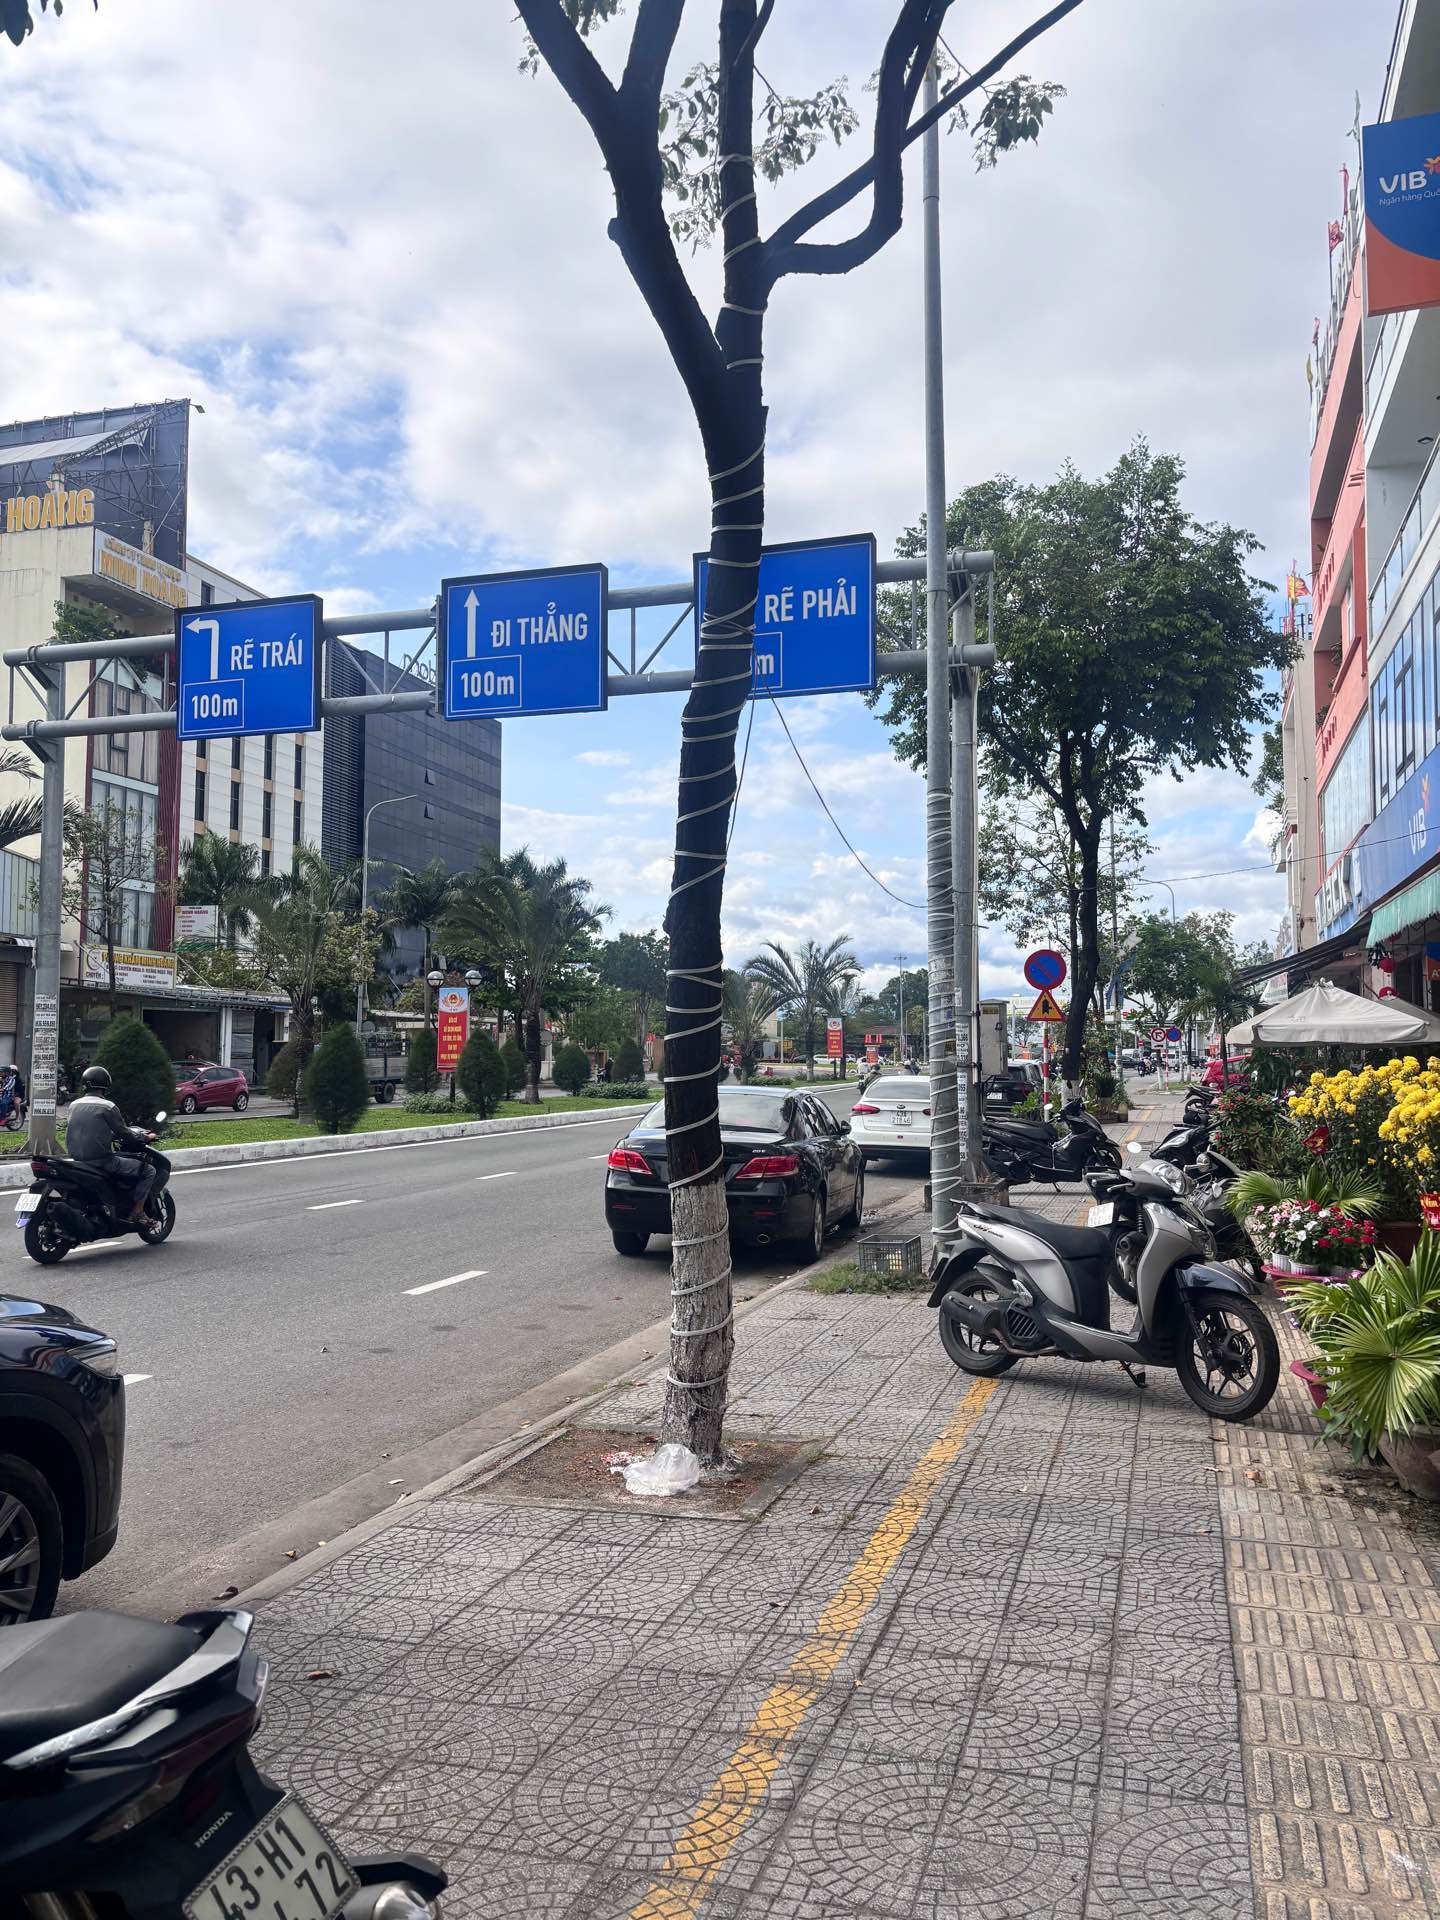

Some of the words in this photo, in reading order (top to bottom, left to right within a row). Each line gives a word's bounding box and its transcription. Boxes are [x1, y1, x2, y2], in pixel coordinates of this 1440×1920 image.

[1379, 170, 1427, 194] VIB
[765, 586, 794, 623] RẼ
[803, 578, 857, 619] PHẢI
[491, 619, 511, 648] ĐI
[517, 602, 588, 645] THẲNG
[230, 639, 254, 671] RẼ
[260, 633, 303, 668] TRÁI
[461, 671, 515, 698] 100m
[191, 694, 238, 719] 100m
[1408, 808, 1427, 855] VIB
[194, 1811, 233, 1848] HONDA
